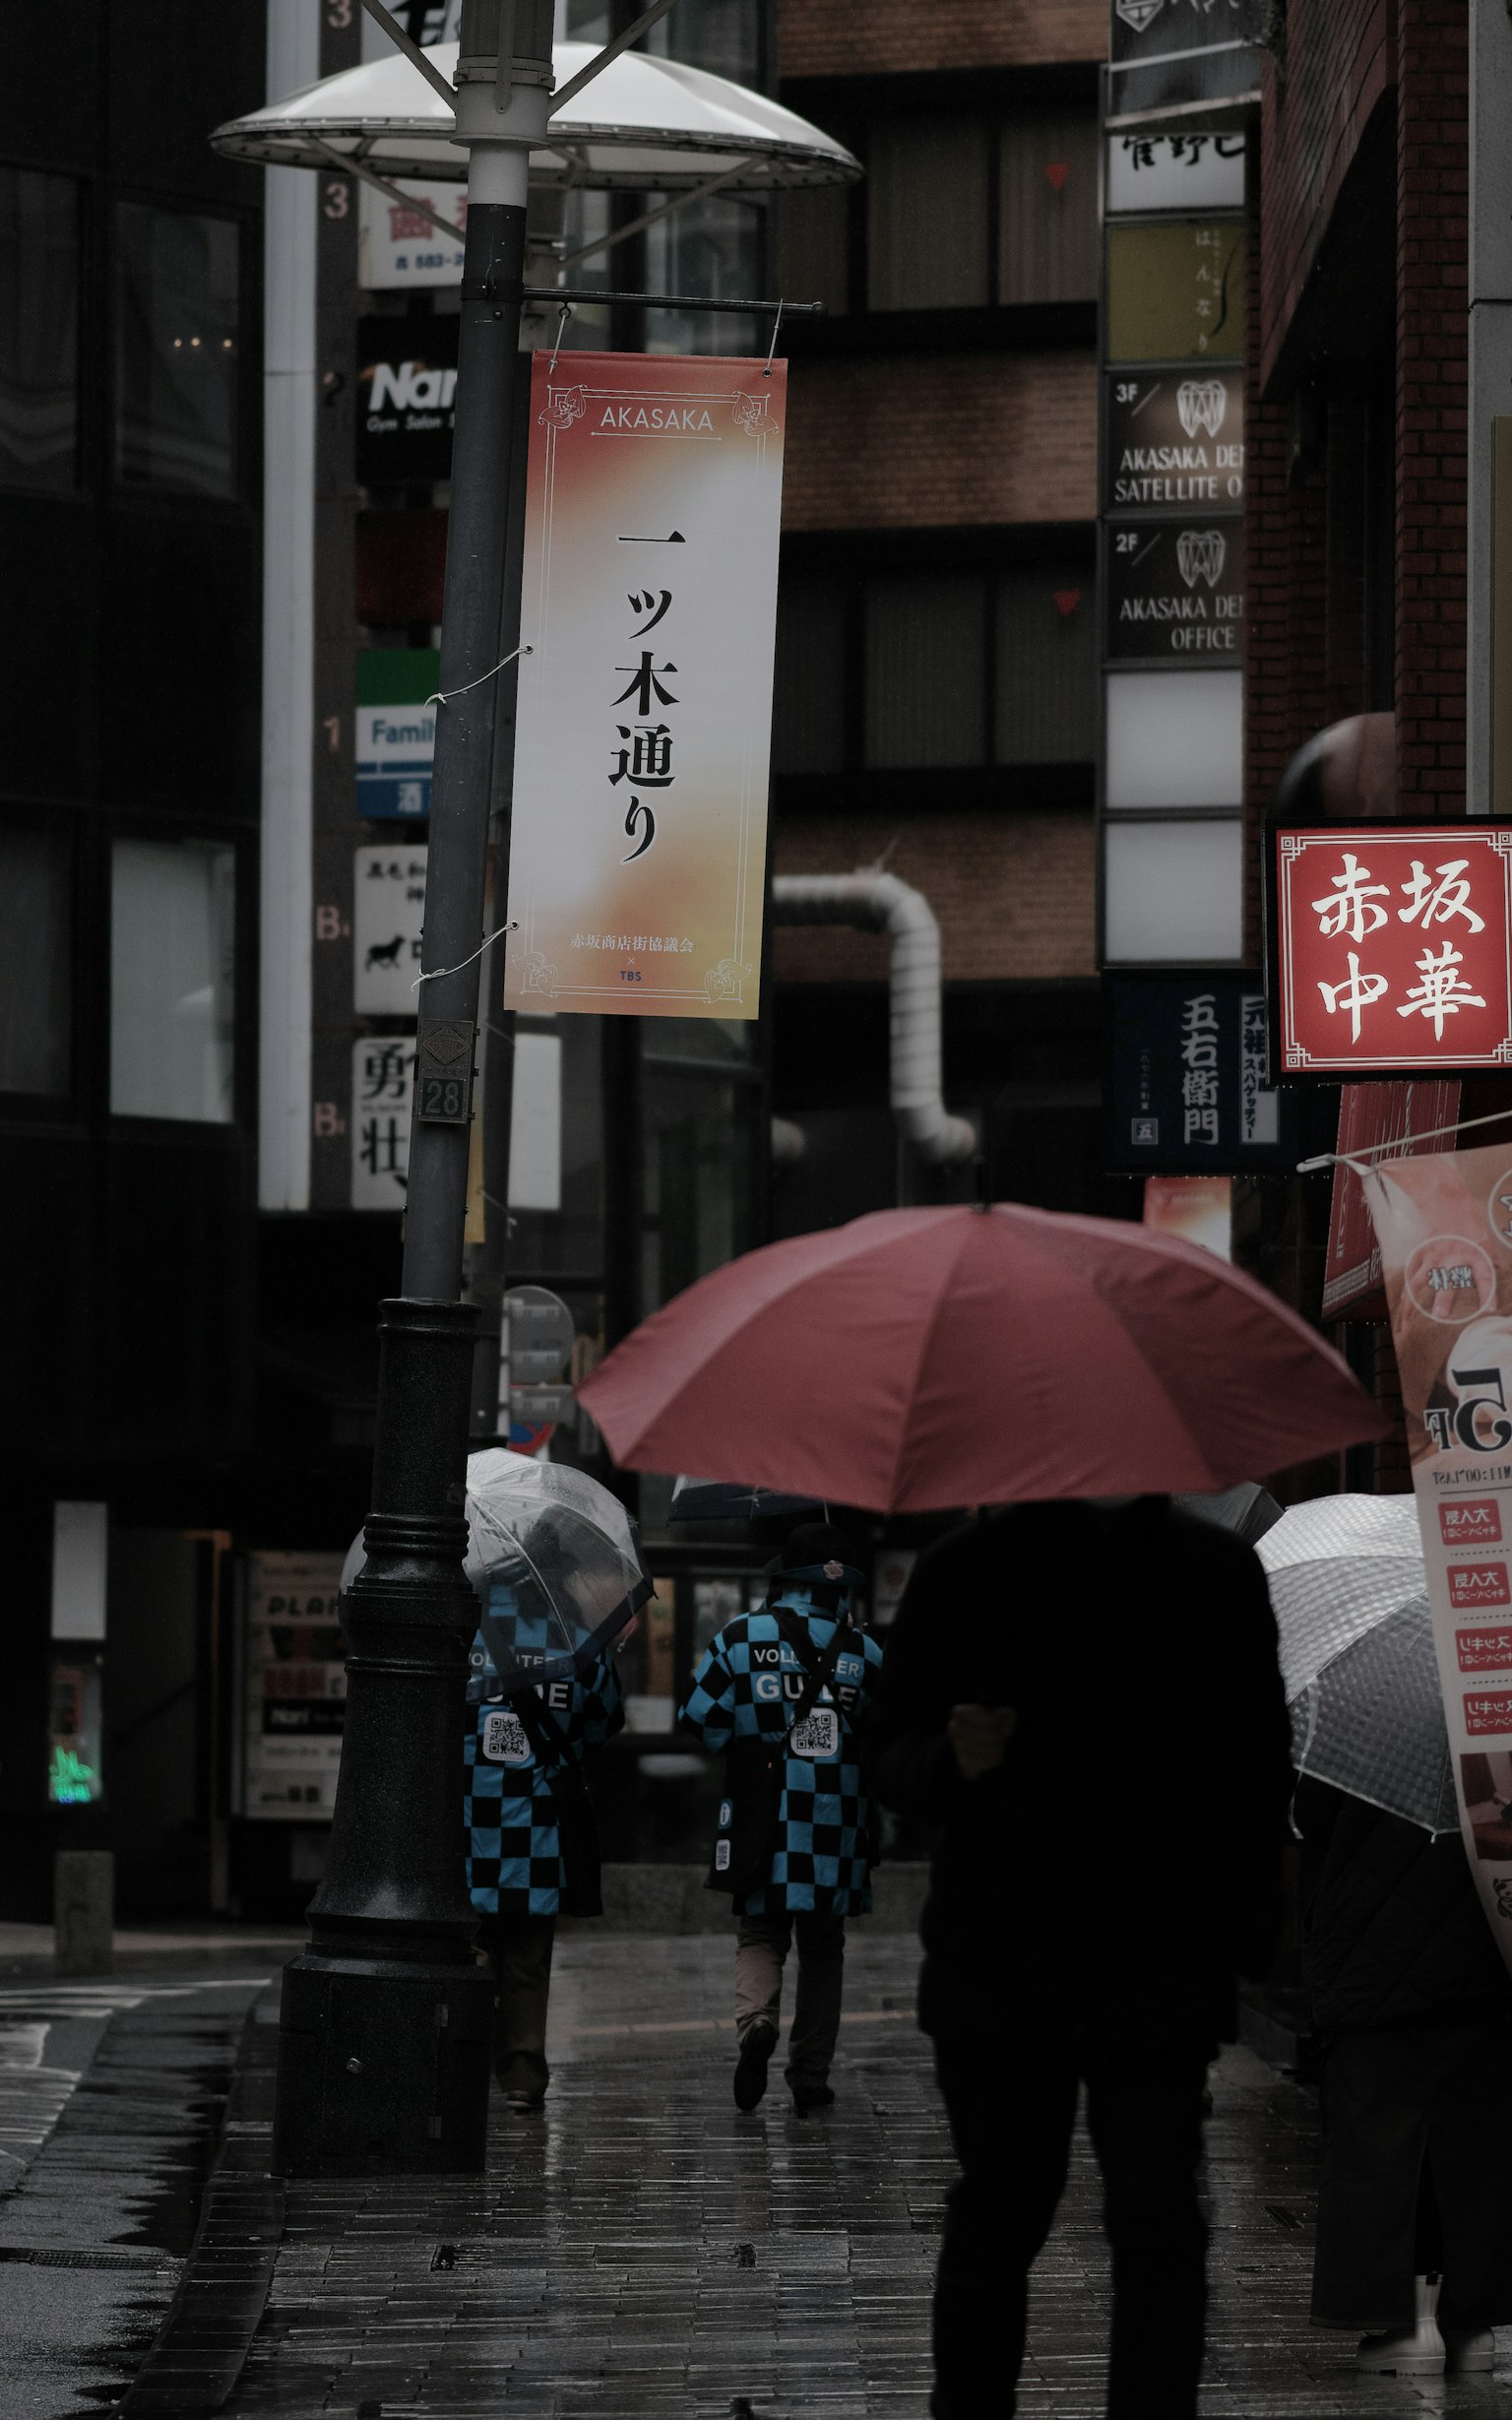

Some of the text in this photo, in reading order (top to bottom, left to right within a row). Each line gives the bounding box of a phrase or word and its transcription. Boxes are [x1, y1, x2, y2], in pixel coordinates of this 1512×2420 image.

[325, 182, 348, 219] 3
[1115, 383, 1138, 404] 3F
[599, 406, 714, 431] AKASAKA
[1120, 446, 1209, 472] AKASAKA
[1114, 475, 1219, 503] SATELLITE
[1115, 533, 1139, 552] 2F
[1119, 596, 1207, 620] AKASAKA
[1170, 625, 1235, 650] OFFICE
[608, 531, 686, 863] 一ツ木通り
[1311, 854, 1486, 943] 赤坂
[571, 933, 694, 953] 赤坂商店街協議会
[620, 970, 642, 982] TBS
[1317, 941, 1487, 1046] 中華
[1180, 993, 1220, 1145] 五右衛門
[424, 1081, 460, 1115] 28
